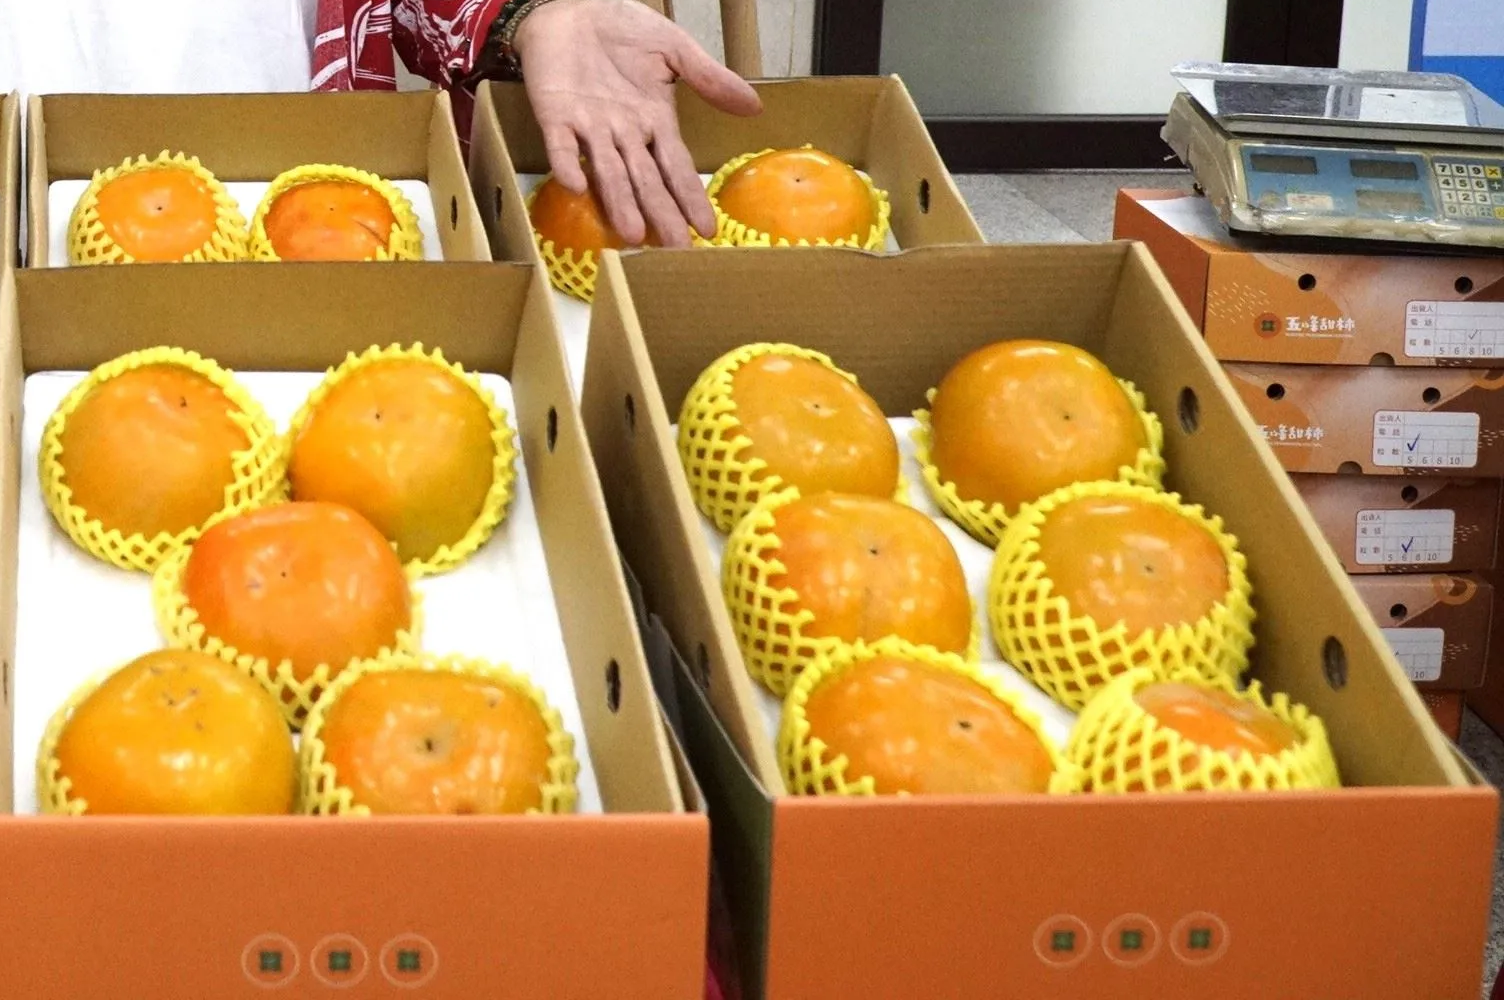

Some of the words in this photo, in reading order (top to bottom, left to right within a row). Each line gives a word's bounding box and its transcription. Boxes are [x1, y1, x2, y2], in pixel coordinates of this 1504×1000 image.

[1438, 165, 1447, 173] 7
[1456, 166, 1465, 174] 8
[1472, 167, 1481, 175] 9
[1442, 179, 1451, 187] 4
[1459, 180, 1468, 188] 5
[1475, 180, 1485, 189] 6
[1462, 193, 1471, 201] 2
[1439, 347, 1445, 355] 5
[1454, 347, 1460, 355] 6
[1469, 347, 1475, 355] 8
[1482, 347, 1493, 355] 10
[1449, 457, 1460, 465] 10
[1388, 553, 1394, 561] 5
[1401, 553, 1407, 561] 6
[1415, 553, 1421, 561] 8
[1427, 553, 1438, 561] 10
